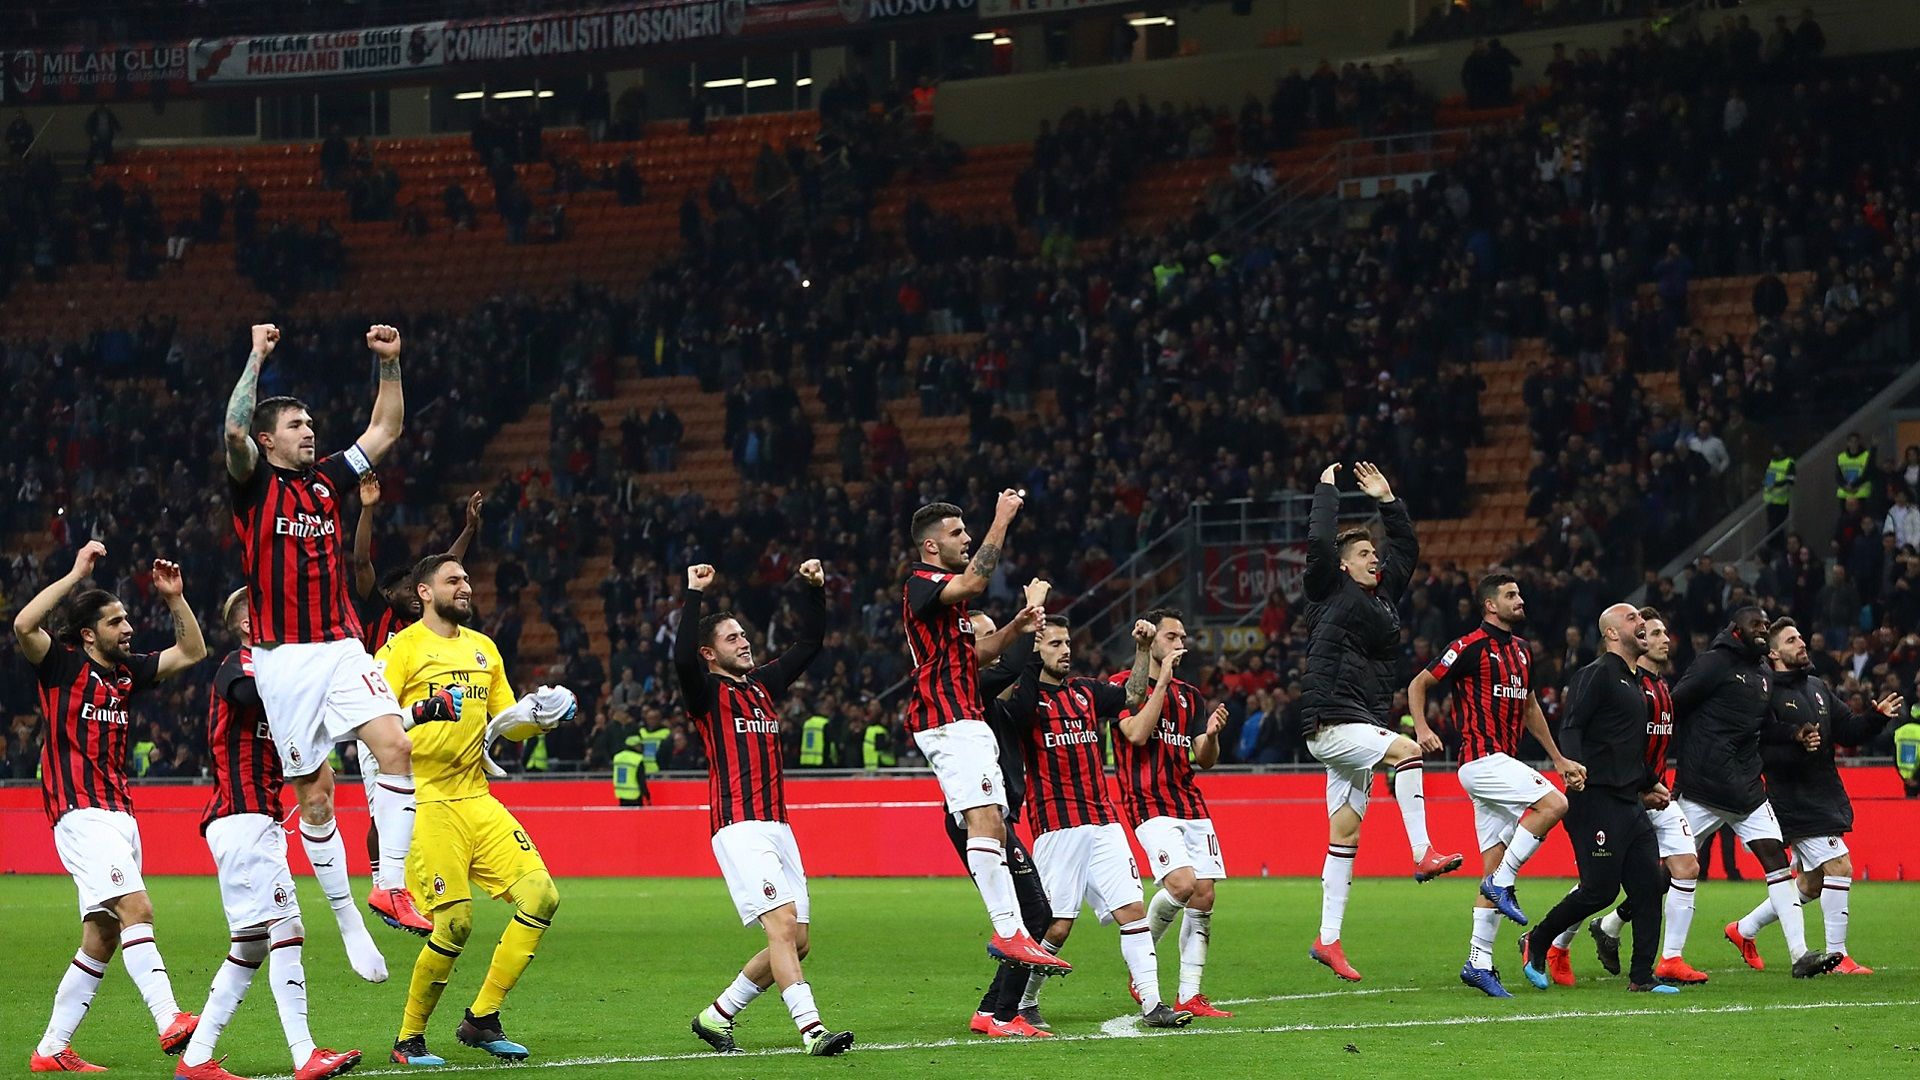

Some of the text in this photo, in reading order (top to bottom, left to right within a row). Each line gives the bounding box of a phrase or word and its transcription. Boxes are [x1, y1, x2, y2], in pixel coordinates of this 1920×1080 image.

[444, 17, 608, 61] COMMERCIALISTI
[613, 3, 721, 47] ROSSONERI
[249, 36, 307, 54] MILAN
[312, 33, 360, 50] CLUB
[43, 48, 185, 74] MILAN CLUB
[247, 46, 401, 75] MARZIANO NUORO
[298, 513, 321, 525] Fly
[361, 671, 388, 696] 13
[451, 670, 469, 683] Fly
[1511, 674, 1521, 687] Fly
[429, 682, 489, 700] Eates
[1493, 684, 1528, 700] Emirate
[110, 696, 121, 709] Fl
[754, 708, 766, 719] Fl
[1661, 711, 1671, 723] Fly
[734, 717, 779, 734] Emirat
[1064, 719, 1082, 730] Fly
[1161, 718, 1175, 732] Fly
[1044, 729, 1098, 748] Emirates
[513, 830, 535, 851] 9
[1207, 834, 1218, 857] 10
[1128, 857, 1139, 880] 8
